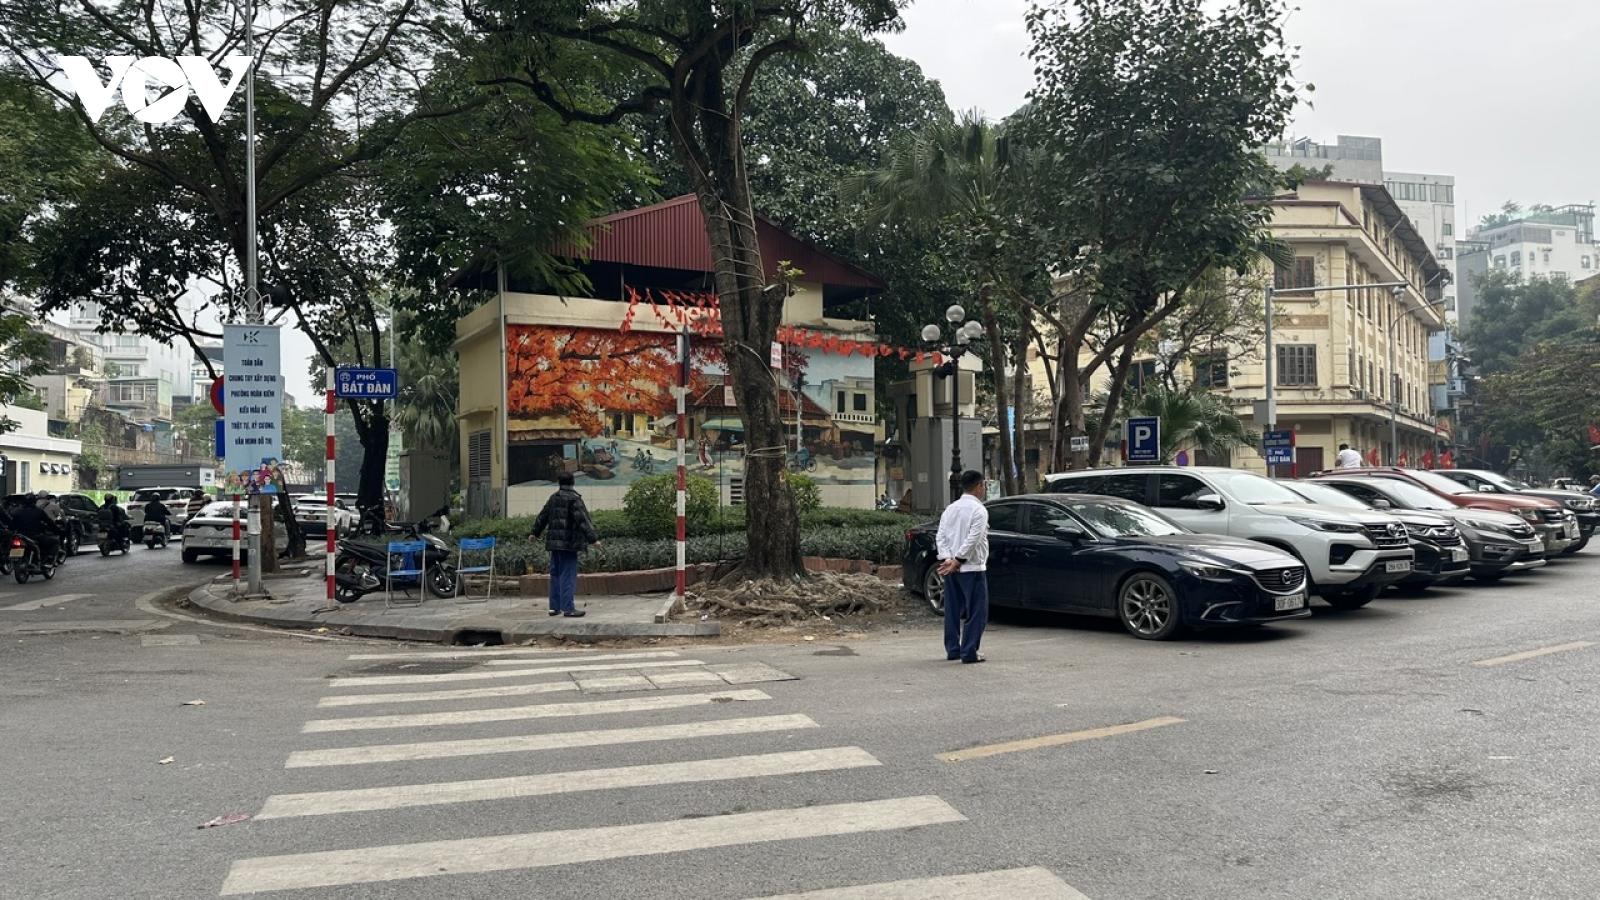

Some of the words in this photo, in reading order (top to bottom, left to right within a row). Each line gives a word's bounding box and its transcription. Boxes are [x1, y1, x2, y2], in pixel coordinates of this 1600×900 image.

[254, 373, 262, 381] XÂY
[356, 371, 376, 380] PHỐ
[342, 380, 364, 393] BÁT
[367, 380, 391, 393] ĐÀN
[1135, 426, 1151, 448] P
